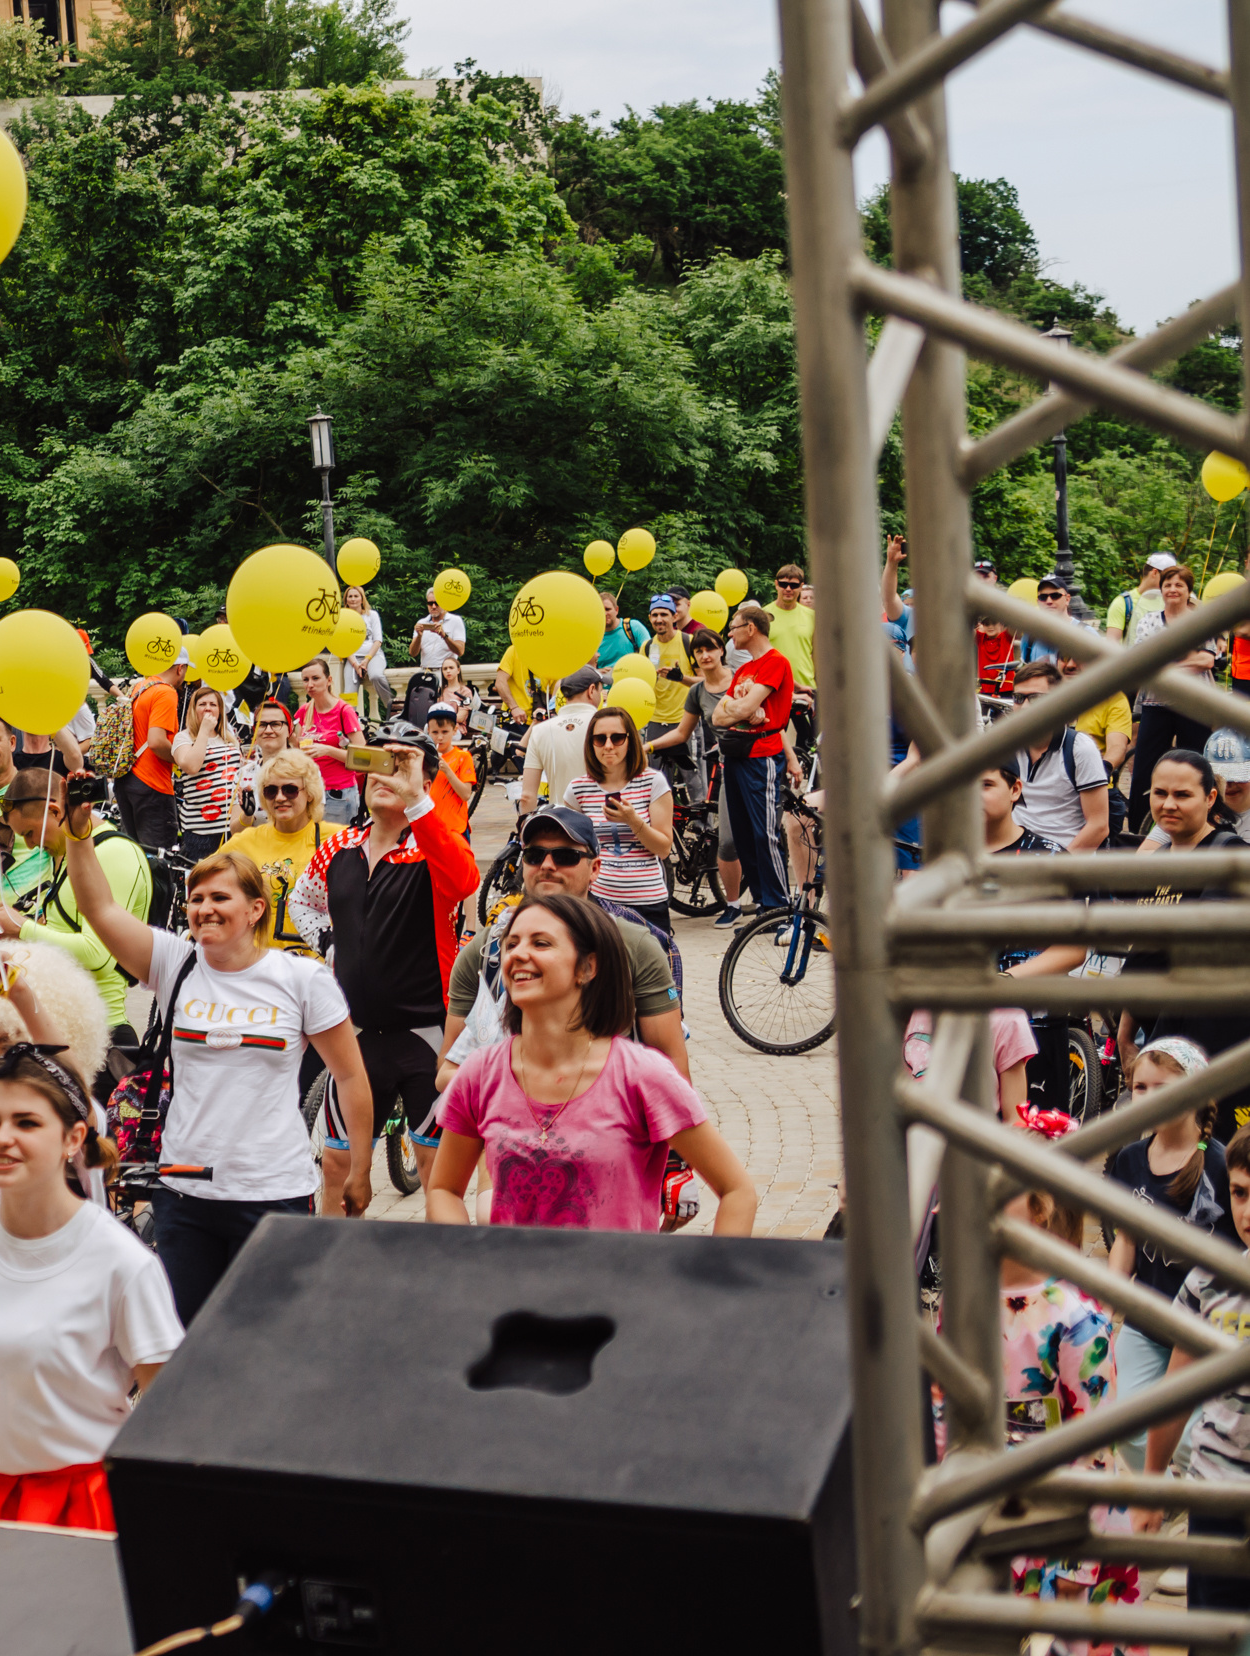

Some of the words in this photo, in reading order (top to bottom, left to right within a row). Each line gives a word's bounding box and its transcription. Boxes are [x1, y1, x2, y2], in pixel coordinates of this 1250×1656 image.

[1154, 884, 1172, 897] THE
[1154, 892, 1183, 907] PARTY
[183, 998, 279, 1026] GUCCI
